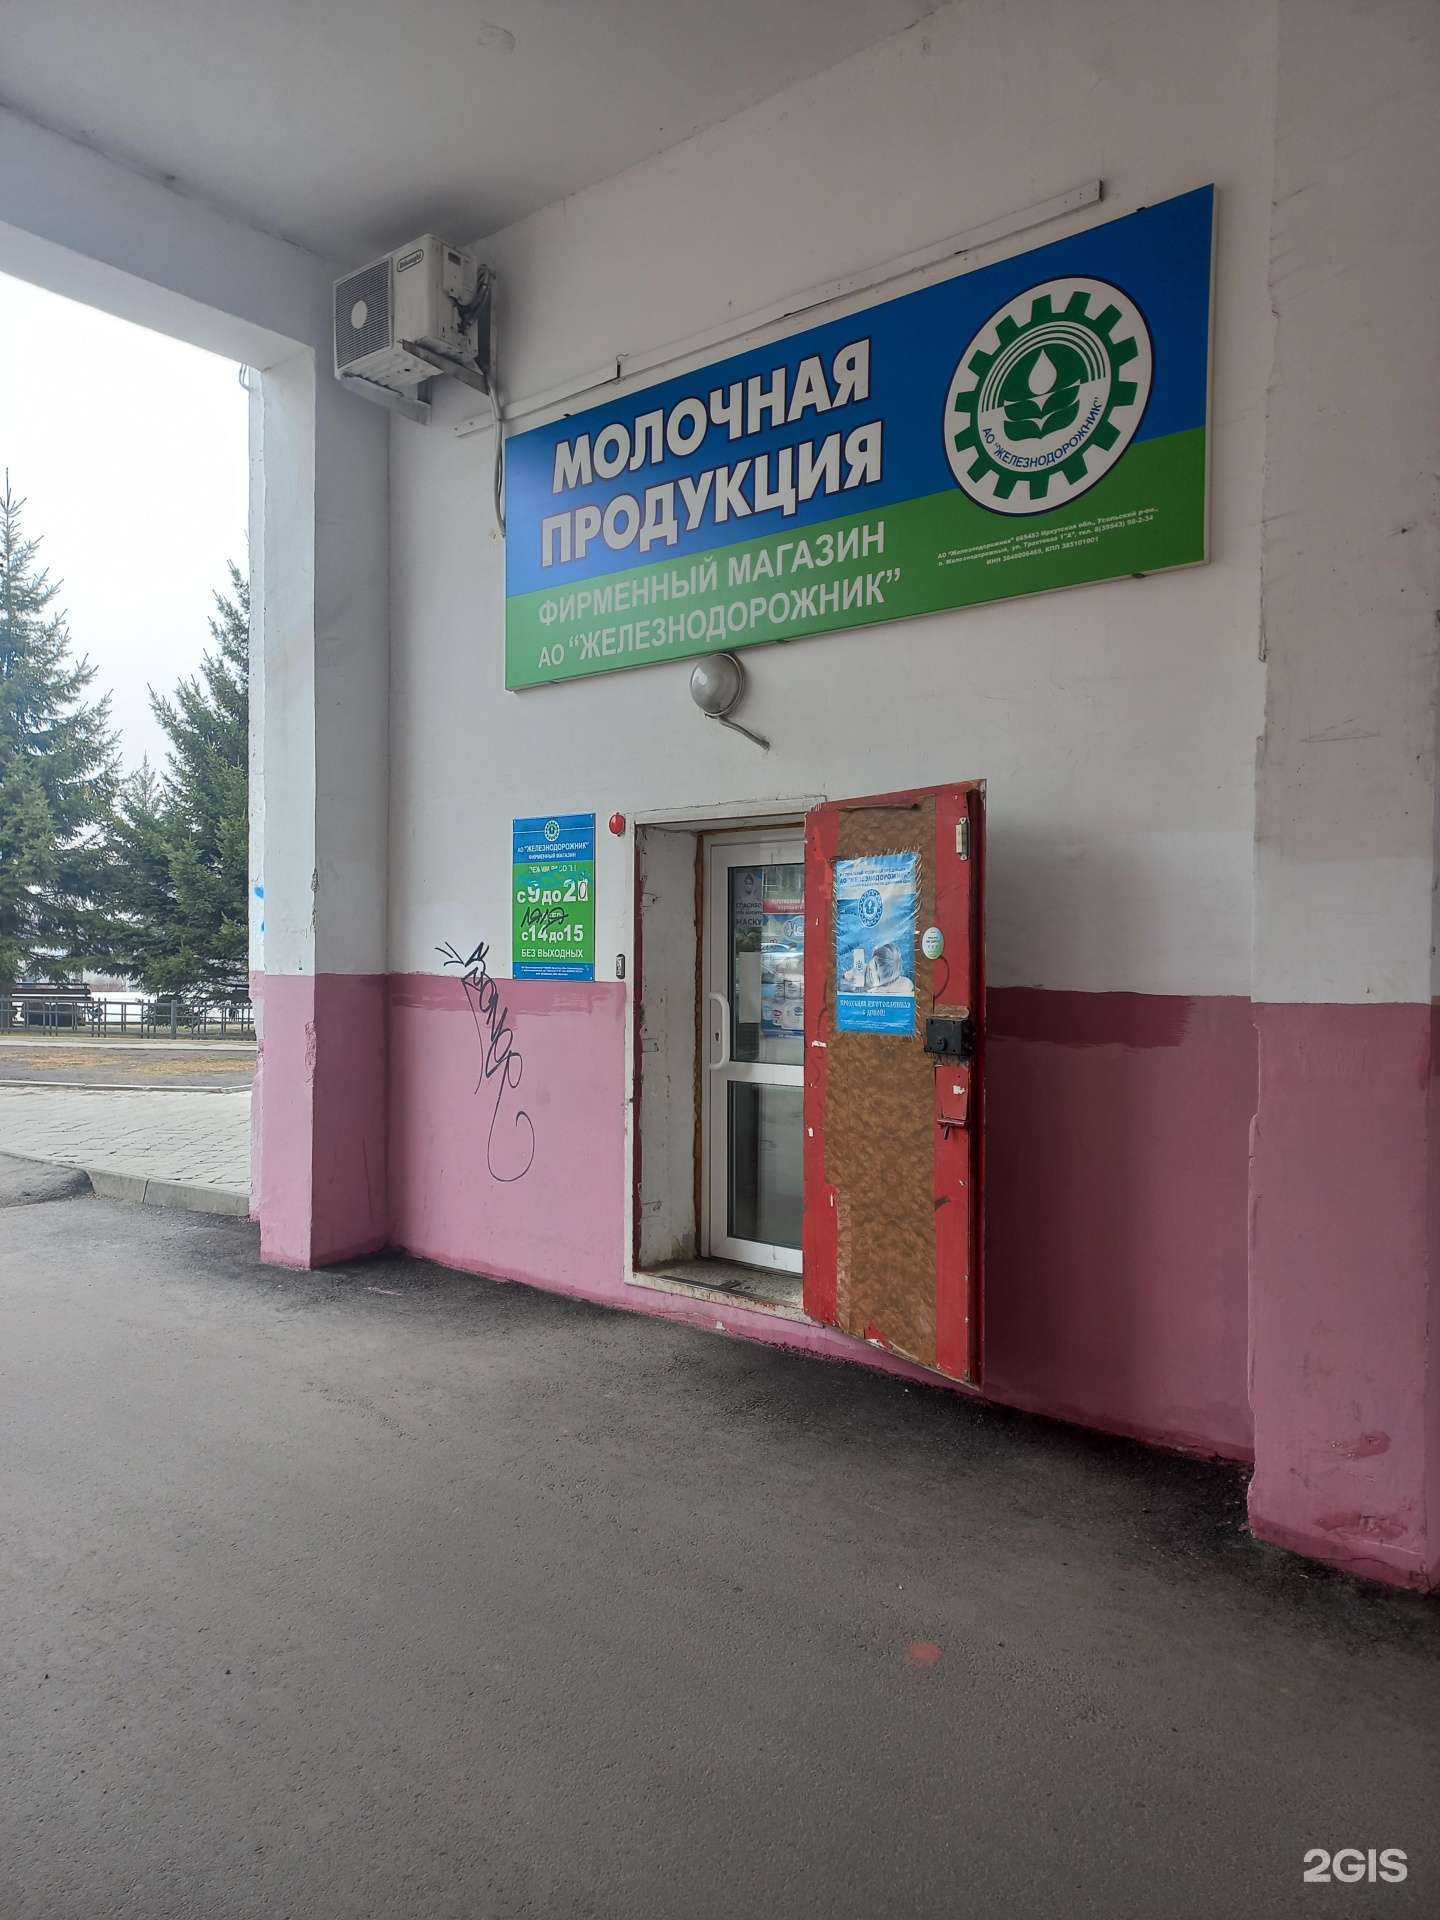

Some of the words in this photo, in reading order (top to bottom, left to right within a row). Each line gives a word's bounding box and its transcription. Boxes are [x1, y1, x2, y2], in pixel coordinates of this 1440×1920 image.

[552, 337, 873, 494] МОЛОЧНАЯ
[982, 427, 996, 446] АО
[540, 420, 884, 568] ПРОДУКЦИЯ
[1045, 544, 1059, 553] КПП
[538, 554, 719, 629] ФИРМЕННЫЙ
[727, 520, 886, 588] МАГАЗИН
[537, 641, 566, 669] АО
[564, 924, 584, 942] 15
[521, 949, 536, 957] БЕЗ
[538, 949, 584, 959] ВЫХОДНЫХ
